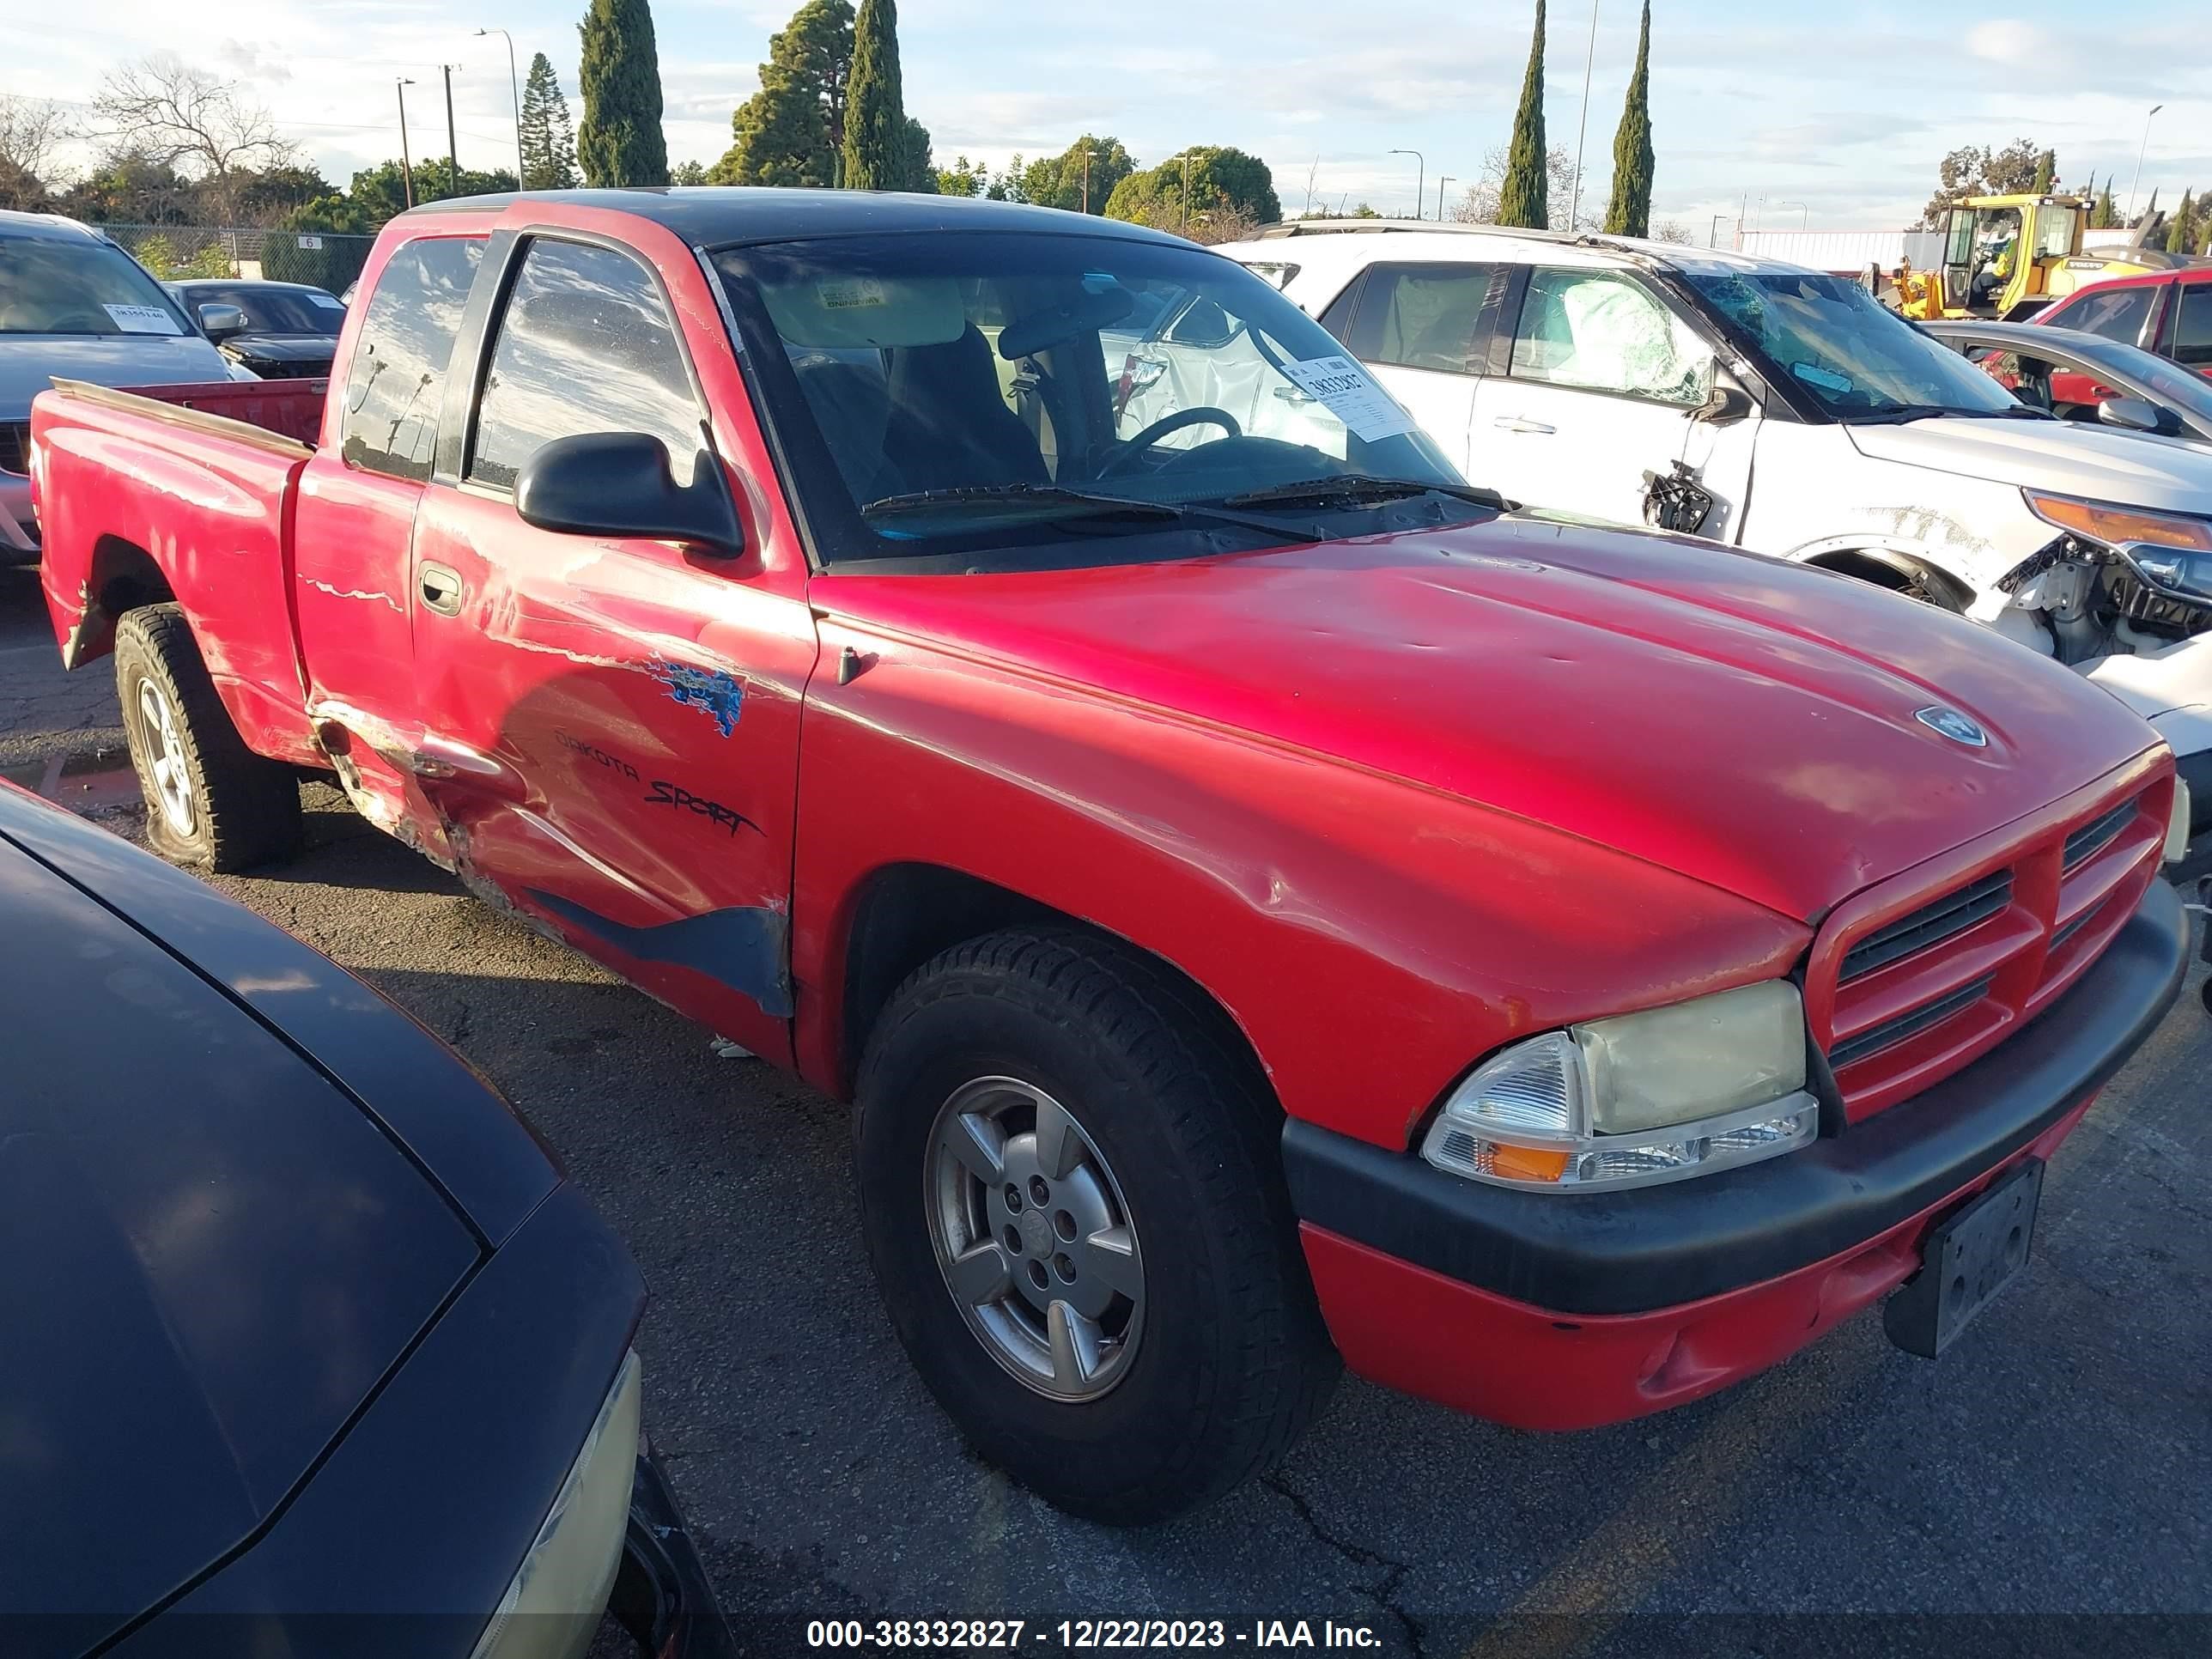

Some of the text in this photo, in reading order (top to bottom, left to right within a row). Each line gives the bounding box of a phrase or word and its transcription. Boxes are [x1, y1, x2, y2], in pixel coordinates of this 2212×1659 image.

[306, 237, 313, 248] 6
[1309, 374, 1365, 395] 38332827
[555, 730, 640, 782] DAKOTA
[644, 781, 768, 838] SPORT
